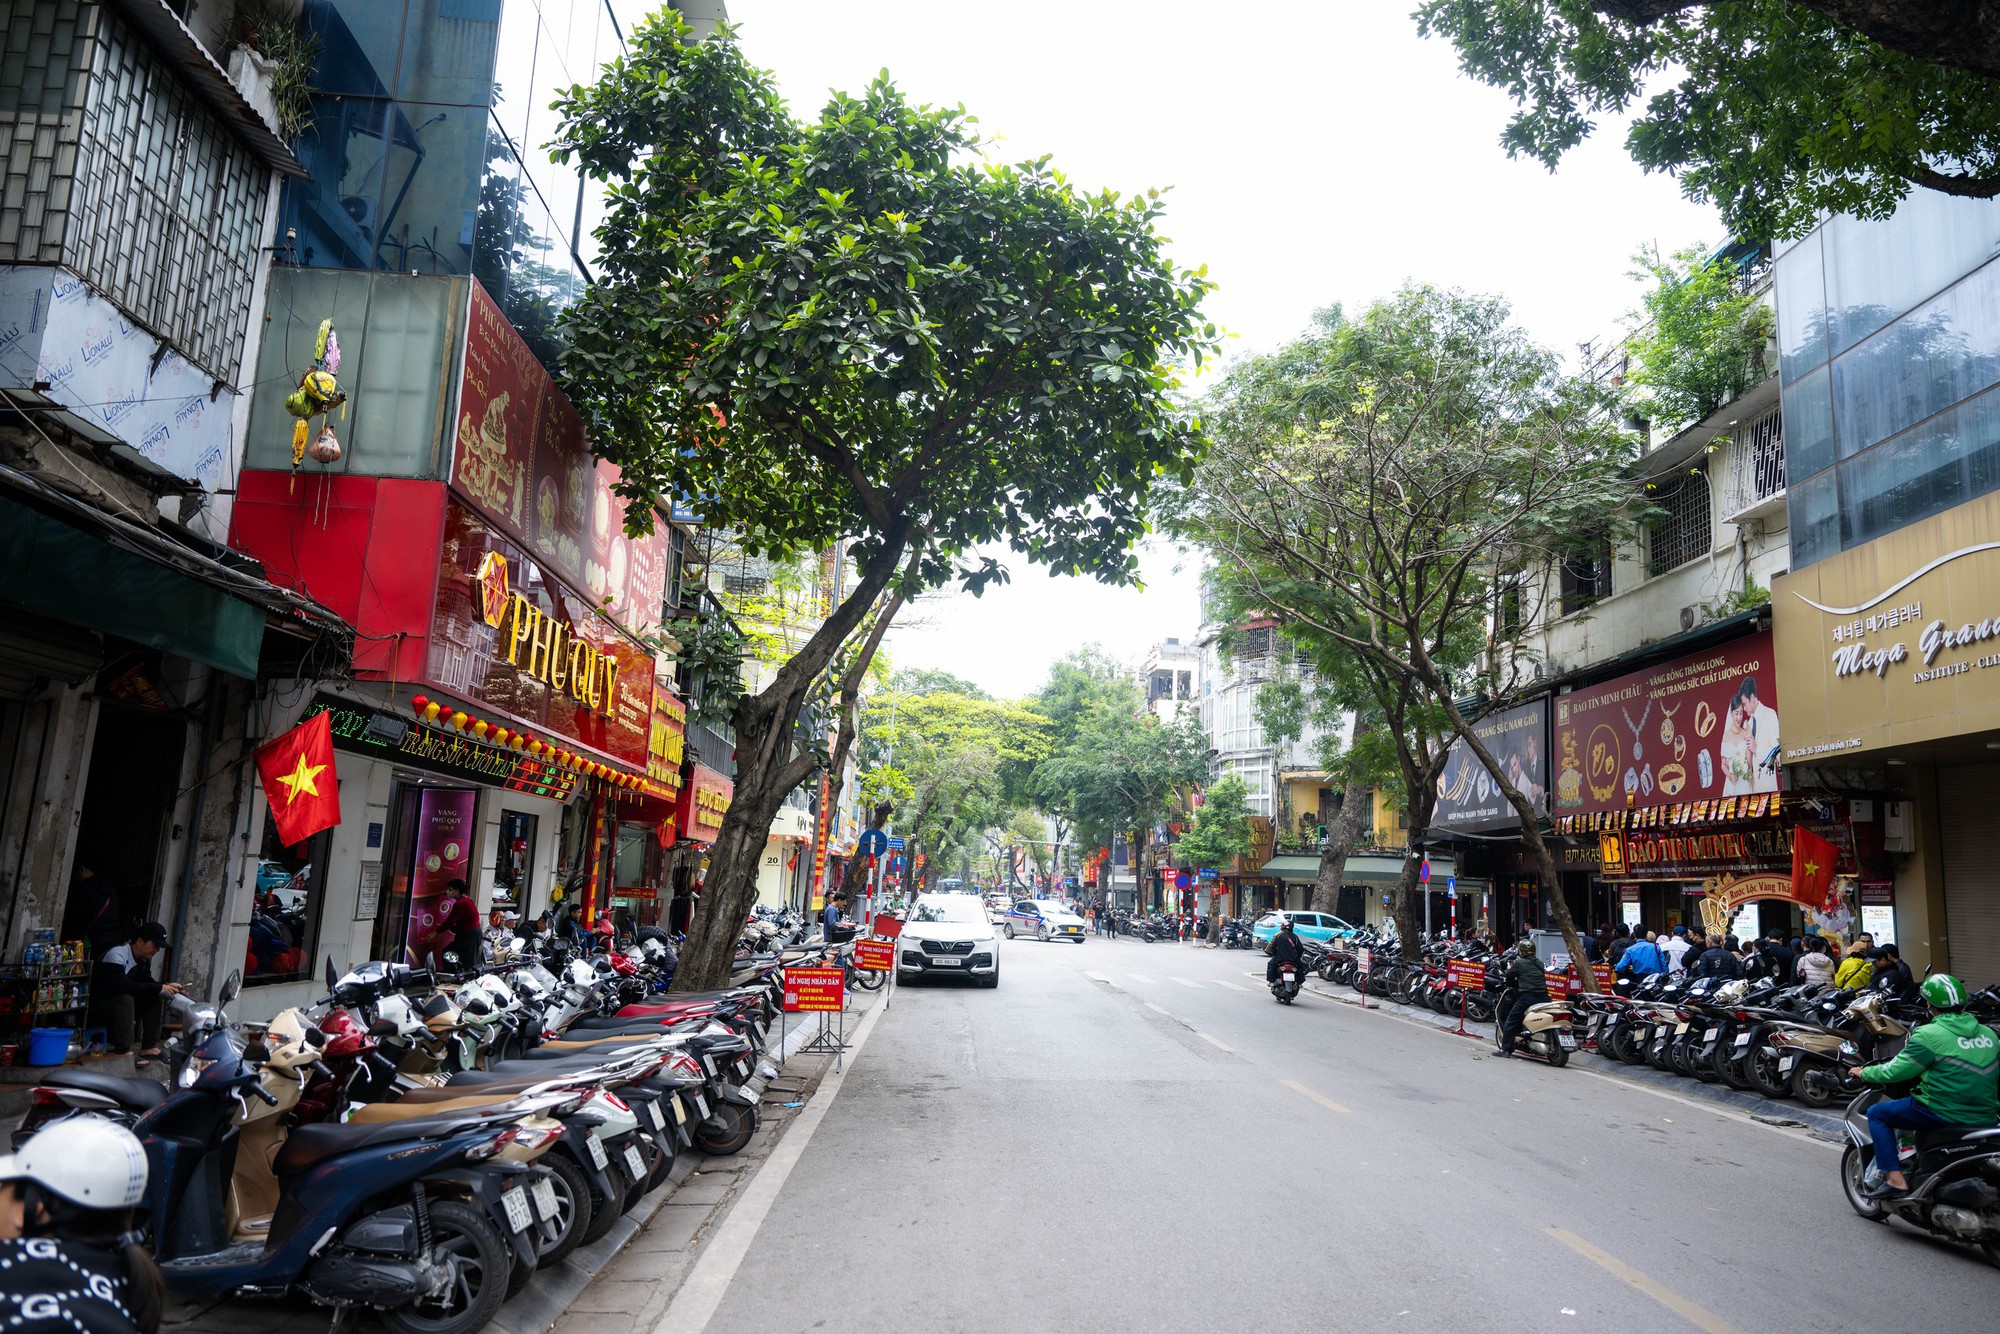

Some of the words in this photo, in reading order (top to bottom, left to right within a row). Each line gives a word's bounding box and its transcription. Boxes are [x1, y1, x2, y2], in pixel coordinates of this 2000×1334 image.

[480, 299, 496, 331] PHÚ
[81, 334, 114, 362] LIONALU
[103, 393, 136, 422] LIONALU
[508, 591, 572, 690] PHÚ
[1649, 673, 1666, 688] VÀNG
[1666, 665, 1684, 684] RỒNG
[1684, 662, 1706, 678] THĂNG
[1706, 656, 1725, 670] LONG
[1832, 642, 1908, 677] Mega
[1913, 661, 1970, 683] INSTITUTE
[1649, 687, 1666, 700] VÀNG
[1666, 681, 1686, 696] TRANG
[1686, 675, 1700, 690] SỨC
[1700, 669, 1718, 686] CHẤT
[1718, 664, 1743, 681] LƯỢNG
[1743, 660, 1760, 673] CAO
[1573, 701, 1588, 714] BẢO
[1587, 695, 1601, 709] TÍN
[1600, 690, 1620, 706] MINH
[1621, 683, 1643, 700] CHÂU
[1479, 725, 1497, 739] TRANG
[1496, 722, 1508, 734] SỨC
[1508, 717, 1523, 730] NAM
[1523, 712, 1538, 726] GIỚI
[399, 731, 445, 760] TRANG
[1829, 739, 1845, 750] NHÂN
[1845, 737, 1862, 748] TÔNG
[438, 808, 458, 816] VÀNG
[1486, 807, 1498, 816] SANG
[1819, 807, 1831, 820] 29
[1628, 831, 1660, 863] BẢO
[1659, 830, 1690, 861] TÍN
[1689, 832, 1741, 861] MINH
[1729, 889, 1745, 899] Rước
[1746, 883, 1757, 895] Lộc
[1758, 881, 1776, 893] Vàng
[788, 975, 797, 985] ĐỀ
[796, 977, 811, 986] NGHỊ
[810, 976, 827, 985] NHÂN
[827, 976, 840, 985] DÂN
[1957, 1035, 1993, 1050] Grab
[25, 1238, 58, 1260] G
[89, 1273, 114, 1303] G
[21, 1293, 60, 1320] G
